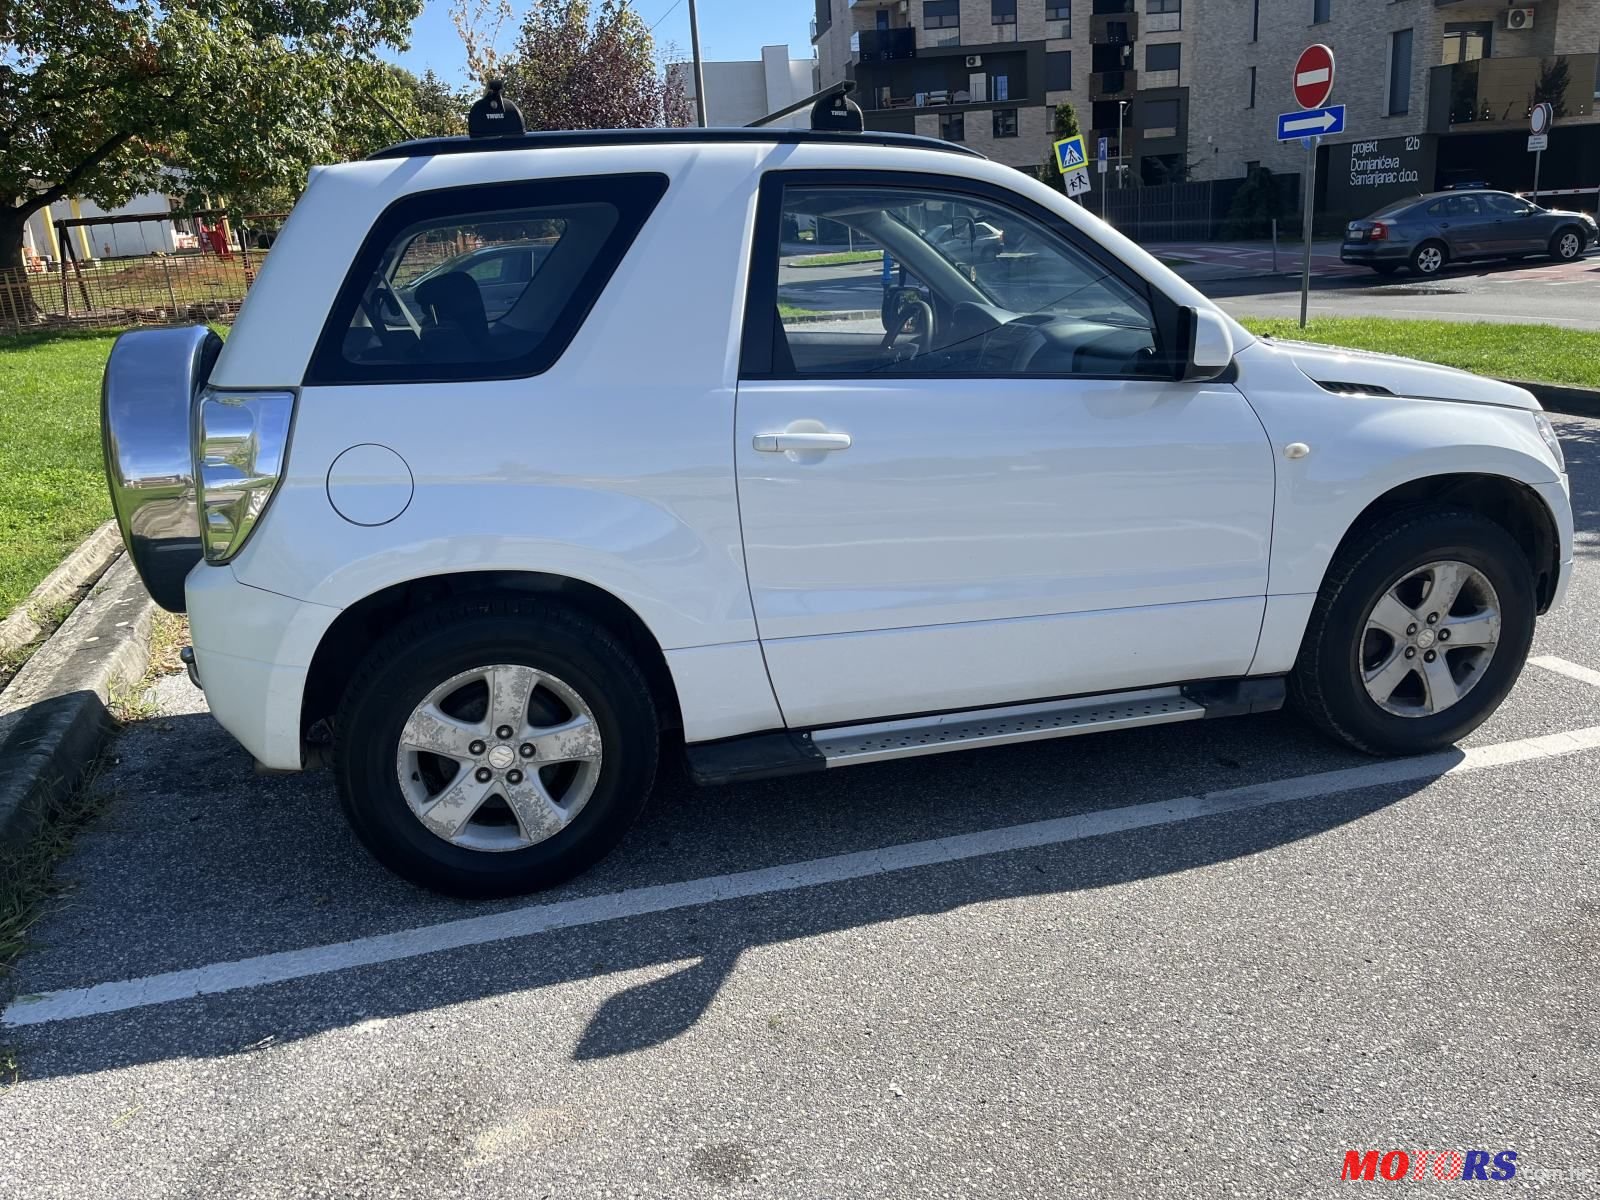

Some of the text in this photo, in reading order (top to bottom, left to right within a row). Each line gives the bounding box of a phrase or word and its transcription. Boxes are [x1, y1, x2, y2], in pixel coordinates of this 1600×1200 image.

[1351, 136, 1420, 157] projekt 12b
[1350, 155, 1400, 173] Domjanićeva
